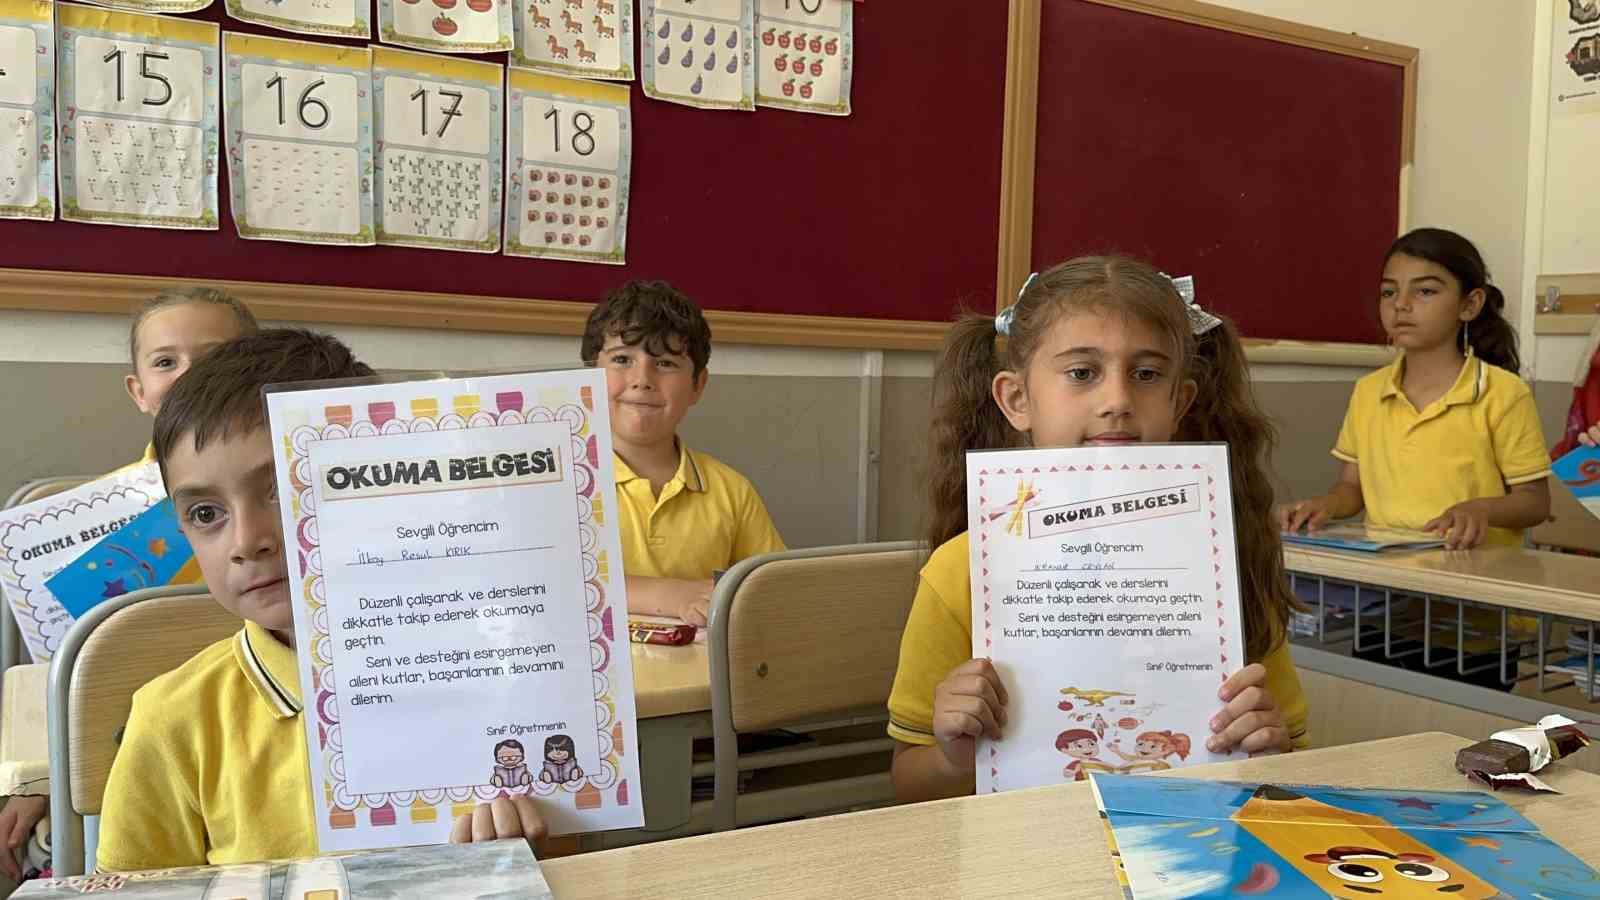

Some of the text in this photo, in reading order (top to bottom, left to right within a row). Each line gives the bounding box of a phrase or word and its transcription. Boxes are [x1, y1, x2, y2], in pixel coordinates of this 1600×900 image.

[103, 45, 173, 105] 15
[266, 72, 330, 130] 16
[410, 85, 464, 139] 17
[544, 105, 596, 156] 18
[326, 447, 556, 491] OKUMA BELGESİ
[1042, 489, 1188, 526] OKUMA BELGESİ
[396, 520, 499, 539] Sevgili Öğrencim
[21, 535, 76, 561] OKUMA
[1060, 541, 1144, 555] Sevgili Öğrencim
[359, 583, 546, 610] Düzenli çalışarak ve derslerini
[1016, 579, 1168, 591] Düzenli çalışarak ve derslerini
[1002, 594, 1044, 605] dikkatle
[1046, 594, 1074, 606] takip
[1077, 594, 1114, 604] ederek
[1116, 594, 1167, 605] okumaya
[342, 603, 544, 630] dikkatle takip ederek okumaya
[1018, 611, 1202, 624] Seni ve desteğini esirgemeyen aileni
[1003, 627, 1039, 639] kutlar,
[1041, 627, 1104, 639] başarılarının
[1106, 627, 1153, 638] devamını
[366, 642, 556, 669] Seni ve desteğini esirgemeyen
[1165, 661, 1214, 674] Öğretmenin
[349, 660, 564, 689] aileni kutlar, başarılarının devamını
[509, 721, 567, 736] Öğretmenin
